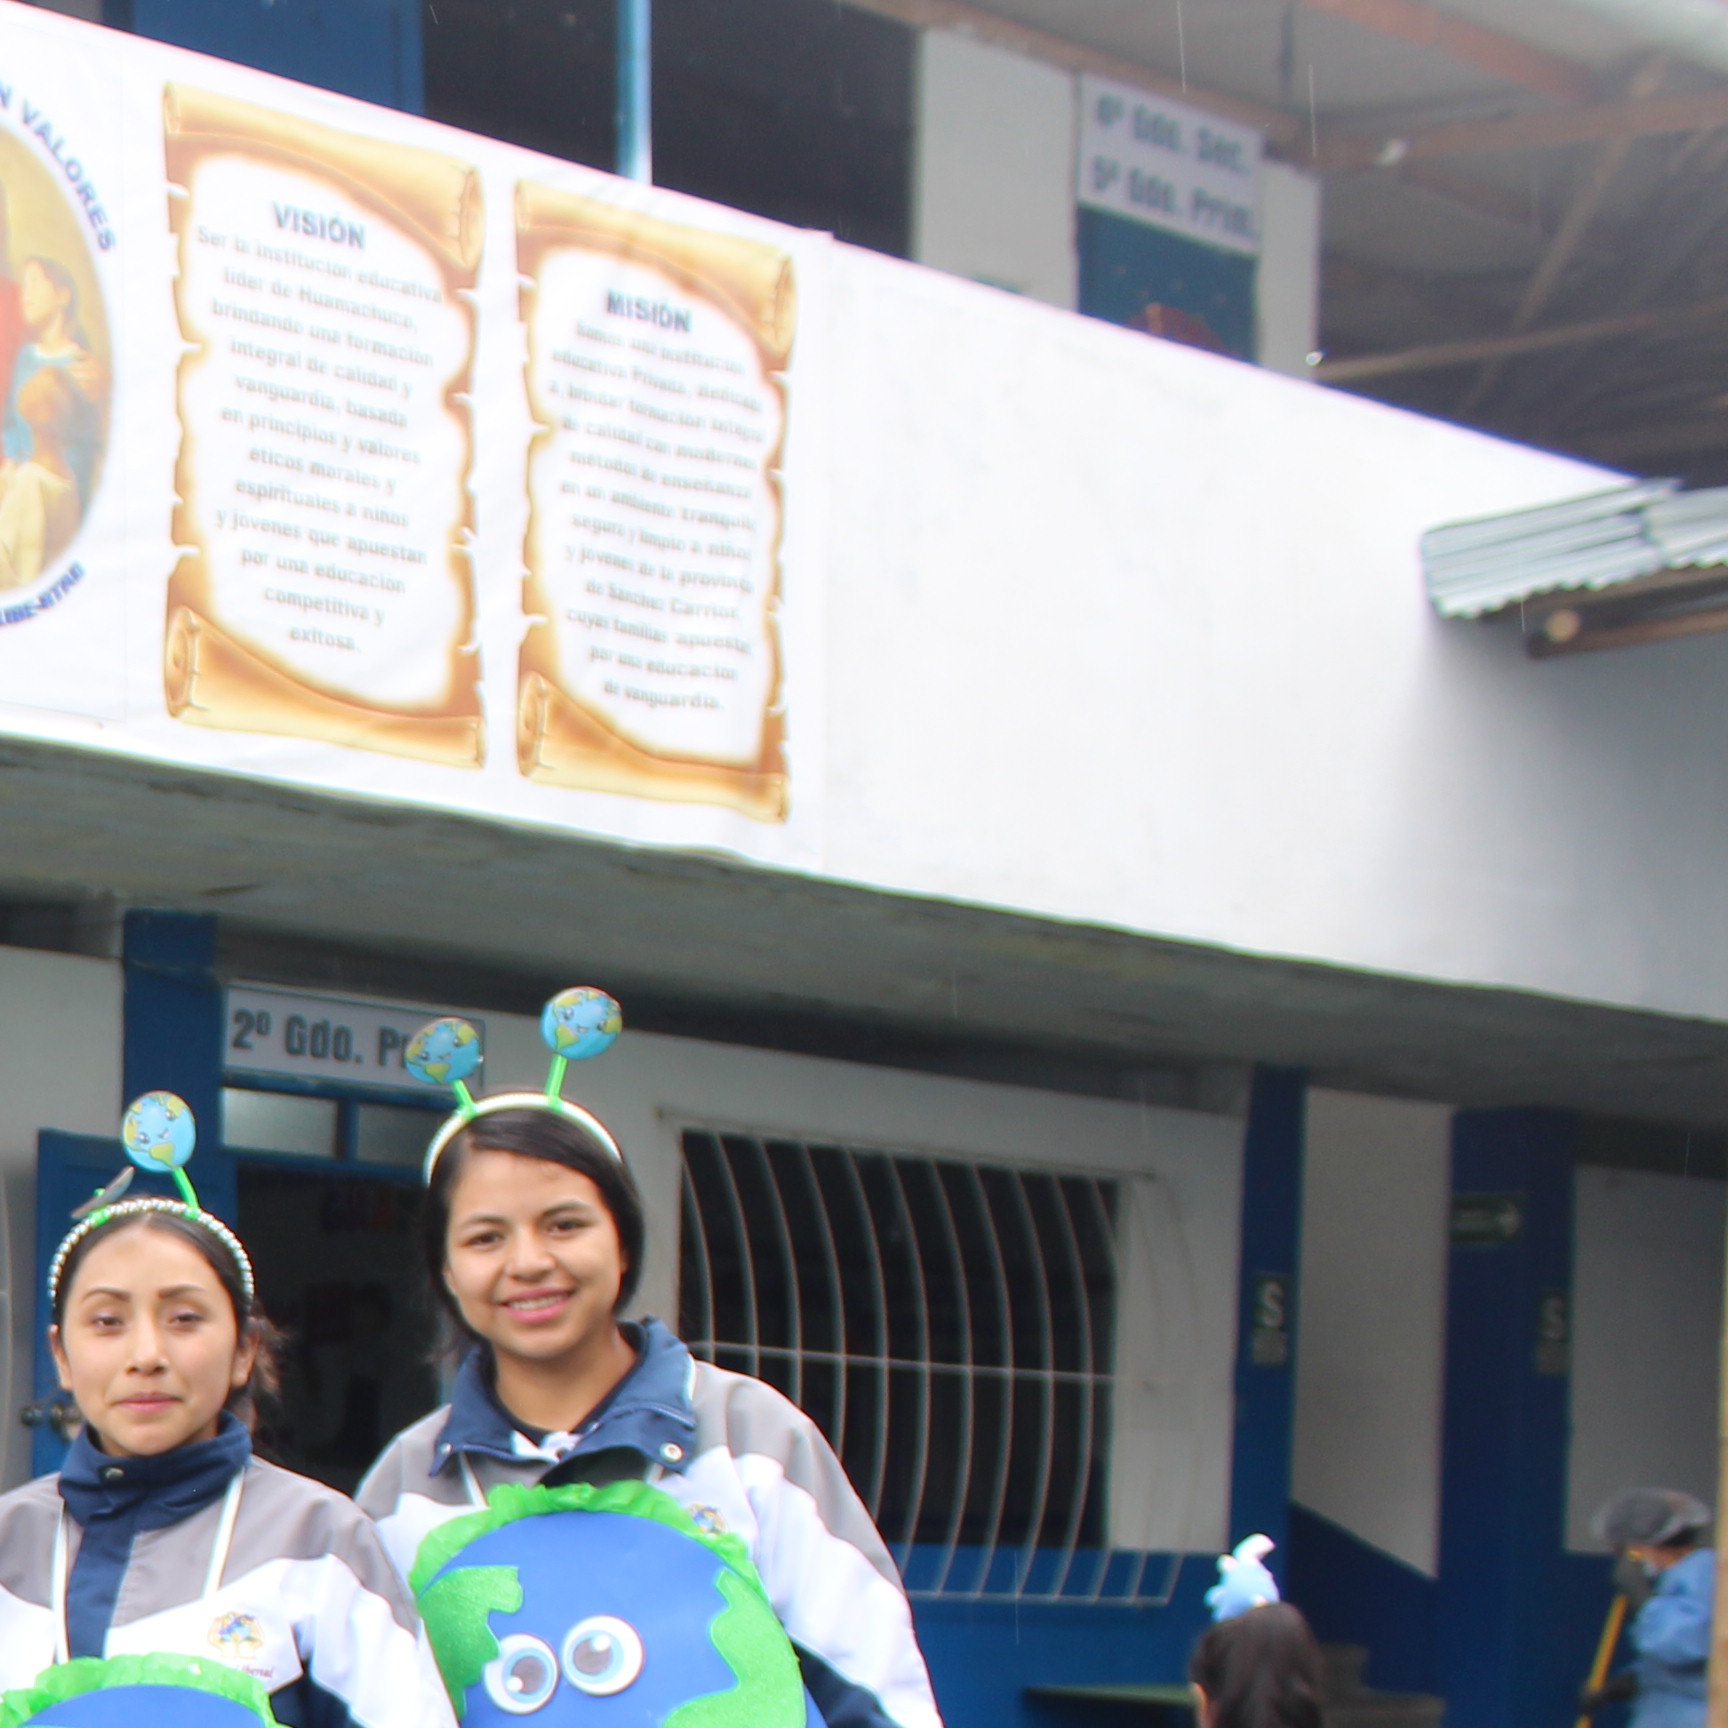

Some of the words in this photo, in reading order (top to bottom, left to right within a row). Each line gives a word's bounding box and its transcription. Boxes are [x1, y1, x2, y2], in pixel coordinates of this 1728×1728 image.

[21, 98, 116, 252] VALORES
[272, 201, 366, 250] VISIÓN
[607, 288, 692, 332] MISIÓN
[285, 1013, 363, 1065] Gdo.
